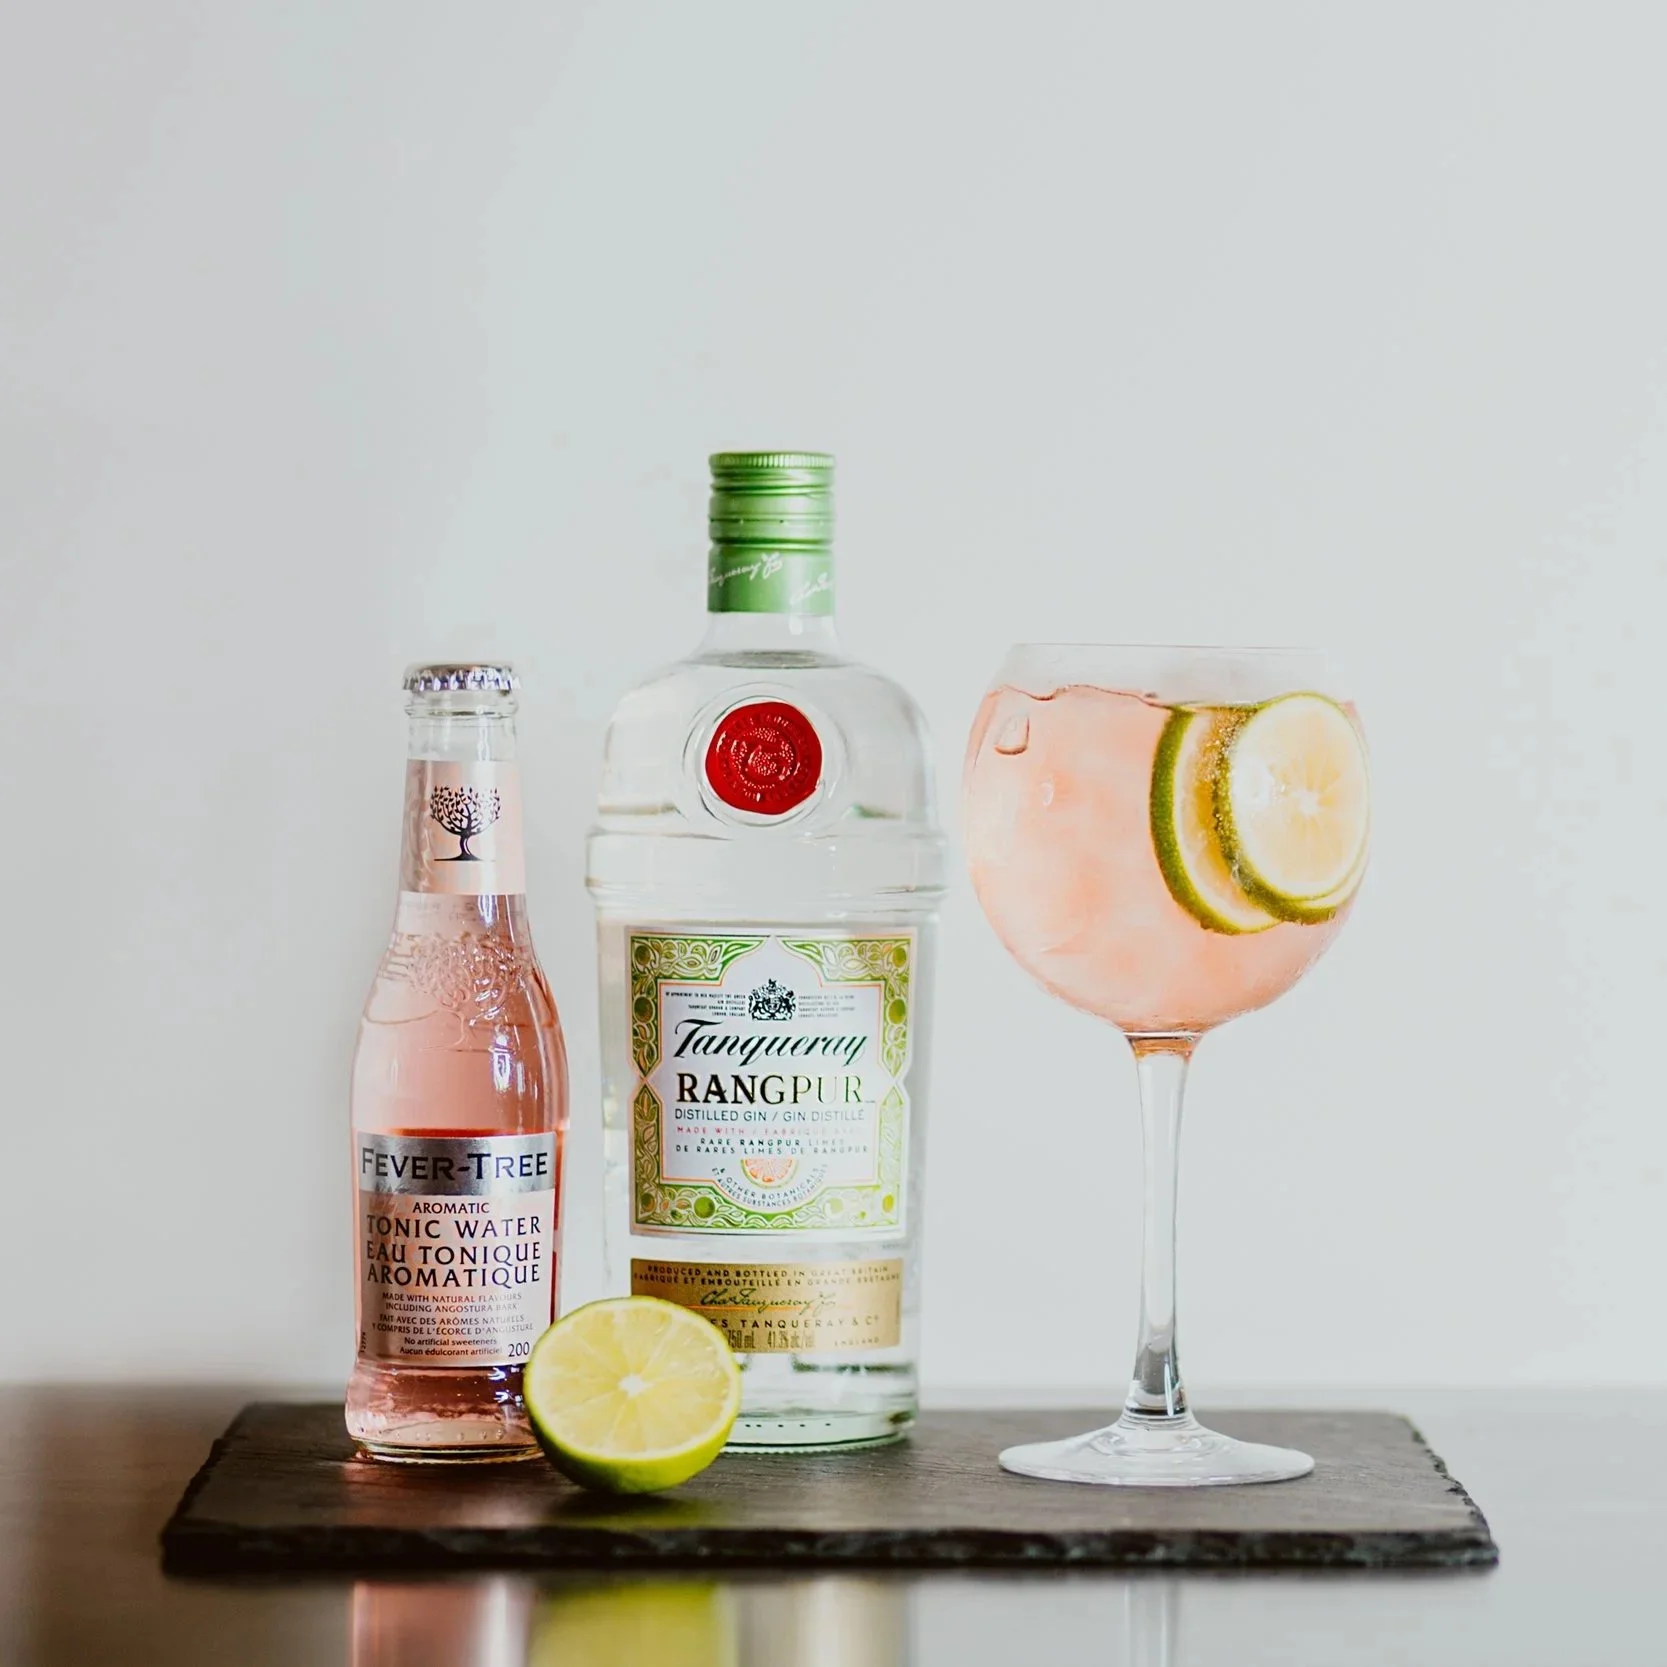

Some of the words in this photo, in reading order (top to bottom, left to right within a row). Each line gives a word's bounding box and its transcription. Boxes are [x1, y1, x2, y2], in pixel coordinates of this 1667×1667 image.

[674, 1018, 867, 1067] Tanqueray
[676, 1072, 862, 1105] RANGPUR
[675, 1109, 738, 1121] DISTILLED
[744, 1111, 767, 1122] GIN
[772, 1110, 778, 1122] /
[783, 1110, 806, 1122] GIN
[811, 1108, 865, 1121] DISTILLÉ
[676, 1126, 707, 1134] MADE
[714, 1127, 745, 1135] WITH
[700, 1138, 731, 1146] RARE
[740, 1138, 800, 1146] RANGPUR
[676, 1145, 689, 1153] DE
[696, 1146, 735, 1154] RARES
[744, 1147, 782, 1155] LIMES
[791, 1147, 804, 1155] DE
[814, 1146, 868, 1154] RANGPUR
[362, 1148, 548, 1181] FEVER-TREE
[726, 1176, 756, 1198] OTHER
[762, 1168, 819, 1200] BOTANICALS
[718, 1178, 741, 1200] AUTRES
[742, 1196, 792, 1208] SUBSTANCES
[412, 1202, 490, 1214] AROMATIC
[367, 1215, 441, 1239] TONIC
[454, 1216, 542, 1239] WATER
[367, 1240, 406, 1263] EAU
[418, 1242, 541, 1266] TONIQUE
[367, 1264, 541, 1289] AROMATIQUE
[648, 1266, 700, 1276] PRODUCED
[736, 1270, 788, 1278] BOTTLED
[811, 1269, 846, 1277] GREAT
[852, 1266, 888, 1275] BRITAIN
[634, 1273, 678, 1284] FABRIQUÉ
[808, 1278, 850, 1286] GRANDE
[382, 1292, 404, 1302] MADE
[407, 1294, 428, 1302] WITH
[432, 1295, 475, 1303] NATURAL
[478, 1292, 522, 1303] FLAVOURS
[386, 1303, 432, 1313] INCLUDING
[435, 1304, 492, 1313] ANGOSTURA
[496, 1303, 518, 1312] BARK
[380, 1314, 394, 1323] FAIT
[396, 1316, 416, 1325] AVEC
[420, 1318, 436, 1326] DES
[440, 1316, 480, 1326] ARÔMES
[740, 1319, 845, 1330] TANQUERAY
[852, 1317, 859, 1326] &
[377, 1324, 410, 1334] COMPRIS
[413, 1326, 424, 1334] DE
[427, 1325, 472, 1336] L'ÉCORCE
[404, 1337, 416, 1345] No
[418, 1338, 450, 1346] artificial
[452, 1338, 497, 1346] sweeteners
[728, 1330, 742, 1348] 750
[400, 1347, 423, 1356] Aucun
[425, 1348, 468, 1356] édulcorant
[470, 1347, 502, 1356] artificiel
[508, 1342, 530, 1358] 200
